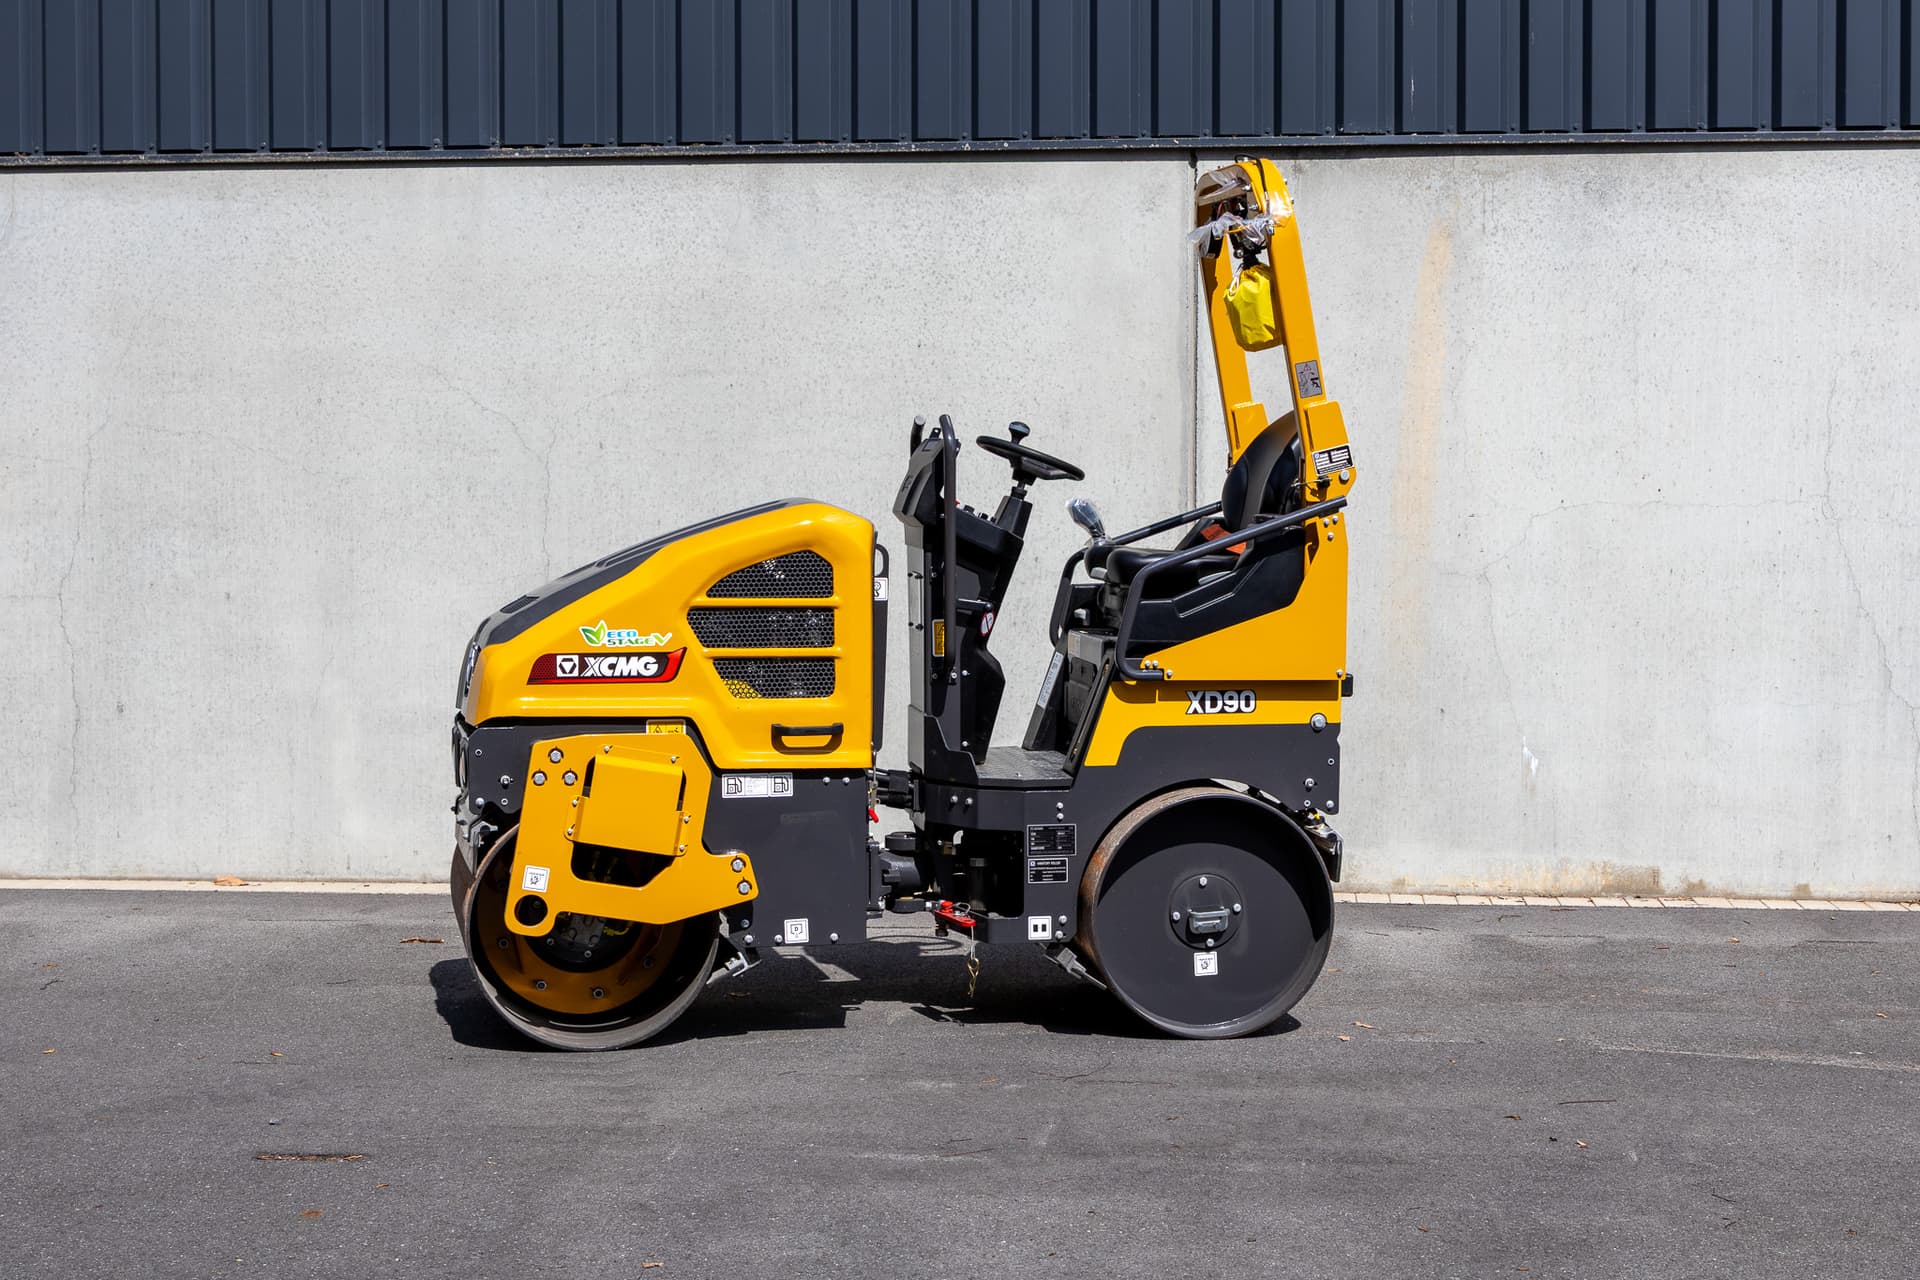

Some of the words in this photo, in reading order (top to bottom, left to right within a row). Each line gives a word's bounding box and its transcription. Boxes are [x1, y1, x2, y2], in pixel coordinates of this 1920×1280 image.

[607, 630, 637, 639] ECO
[607, 638, 654, 646] STAGE
[580, 655, 659, 677] XCMG
[1185, 690, 1256, 714] XD90
